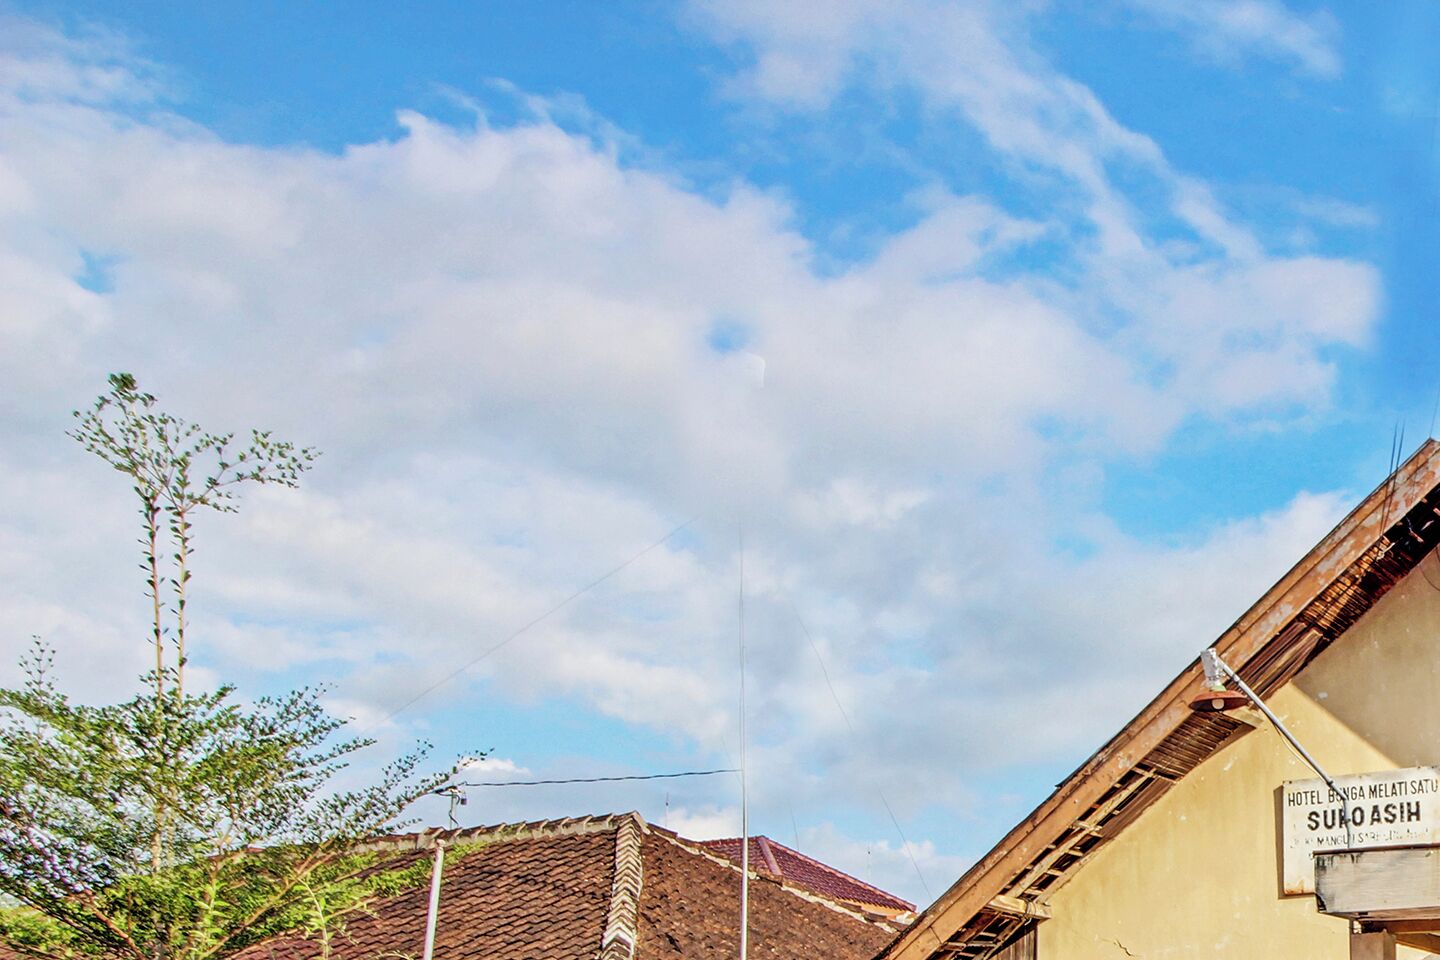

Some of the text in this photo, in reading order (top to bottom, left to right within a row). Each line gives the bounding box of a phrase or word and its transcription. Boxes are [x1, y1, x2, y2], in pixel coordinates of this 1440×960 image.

[1287, 790, 1323, 807] HOTEL
[1368, 780, 1408, 799] MELATI
[1410, 779, 1438, 795] SATU
[1369, 801, 1420, 826] ASIH
